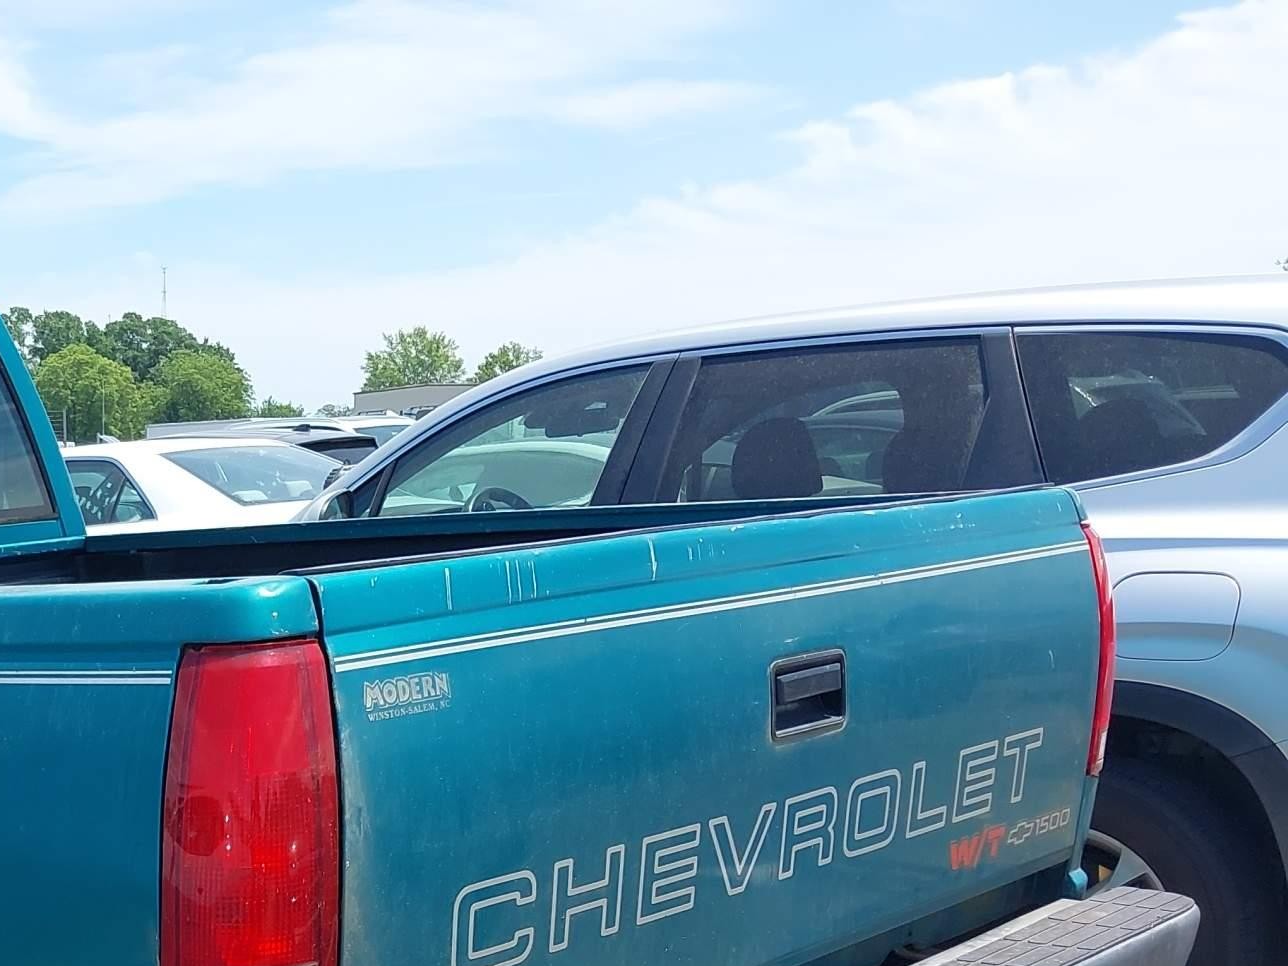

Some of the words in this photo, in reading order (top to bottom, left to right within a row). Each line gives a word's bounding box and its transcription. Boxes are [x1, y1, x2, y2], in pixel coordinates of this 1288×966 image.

[364, 672, 451, 711] MODERN
[367, 702, 439, 722] WINSTON-SALEM,
[949, 824, 1007, 871] W/T
[1034, 807, 1071, 836] 1500
